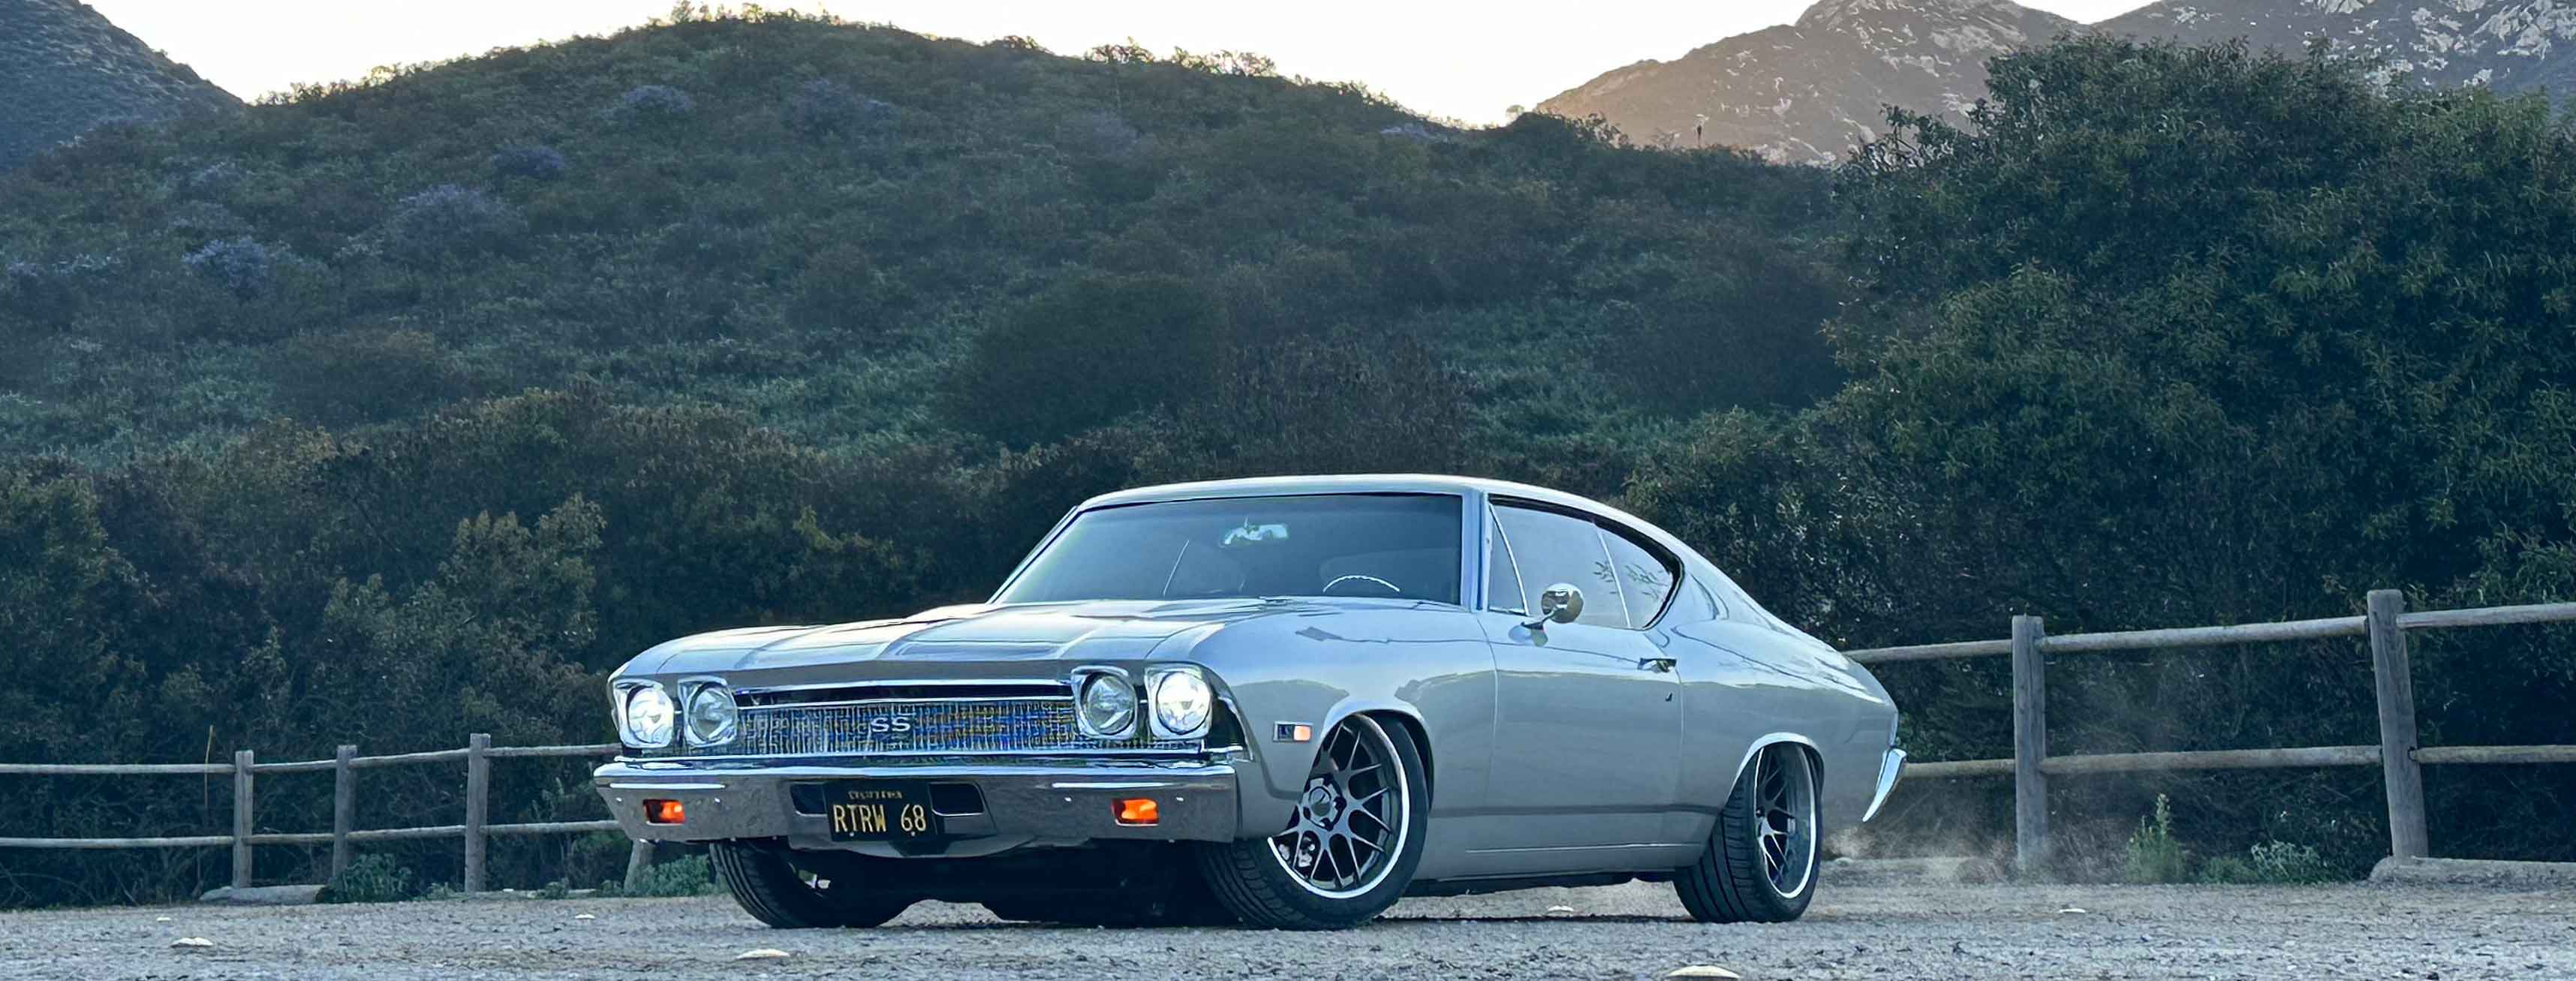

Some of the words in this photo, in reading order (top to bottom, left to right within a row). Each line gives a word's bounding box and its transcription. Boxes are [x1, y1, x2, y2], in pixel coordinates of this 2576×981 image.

[870, 717, 910, 733] SS
[833, 804, 886, 832] RTRW
[901, 803, 926, 832] 68
